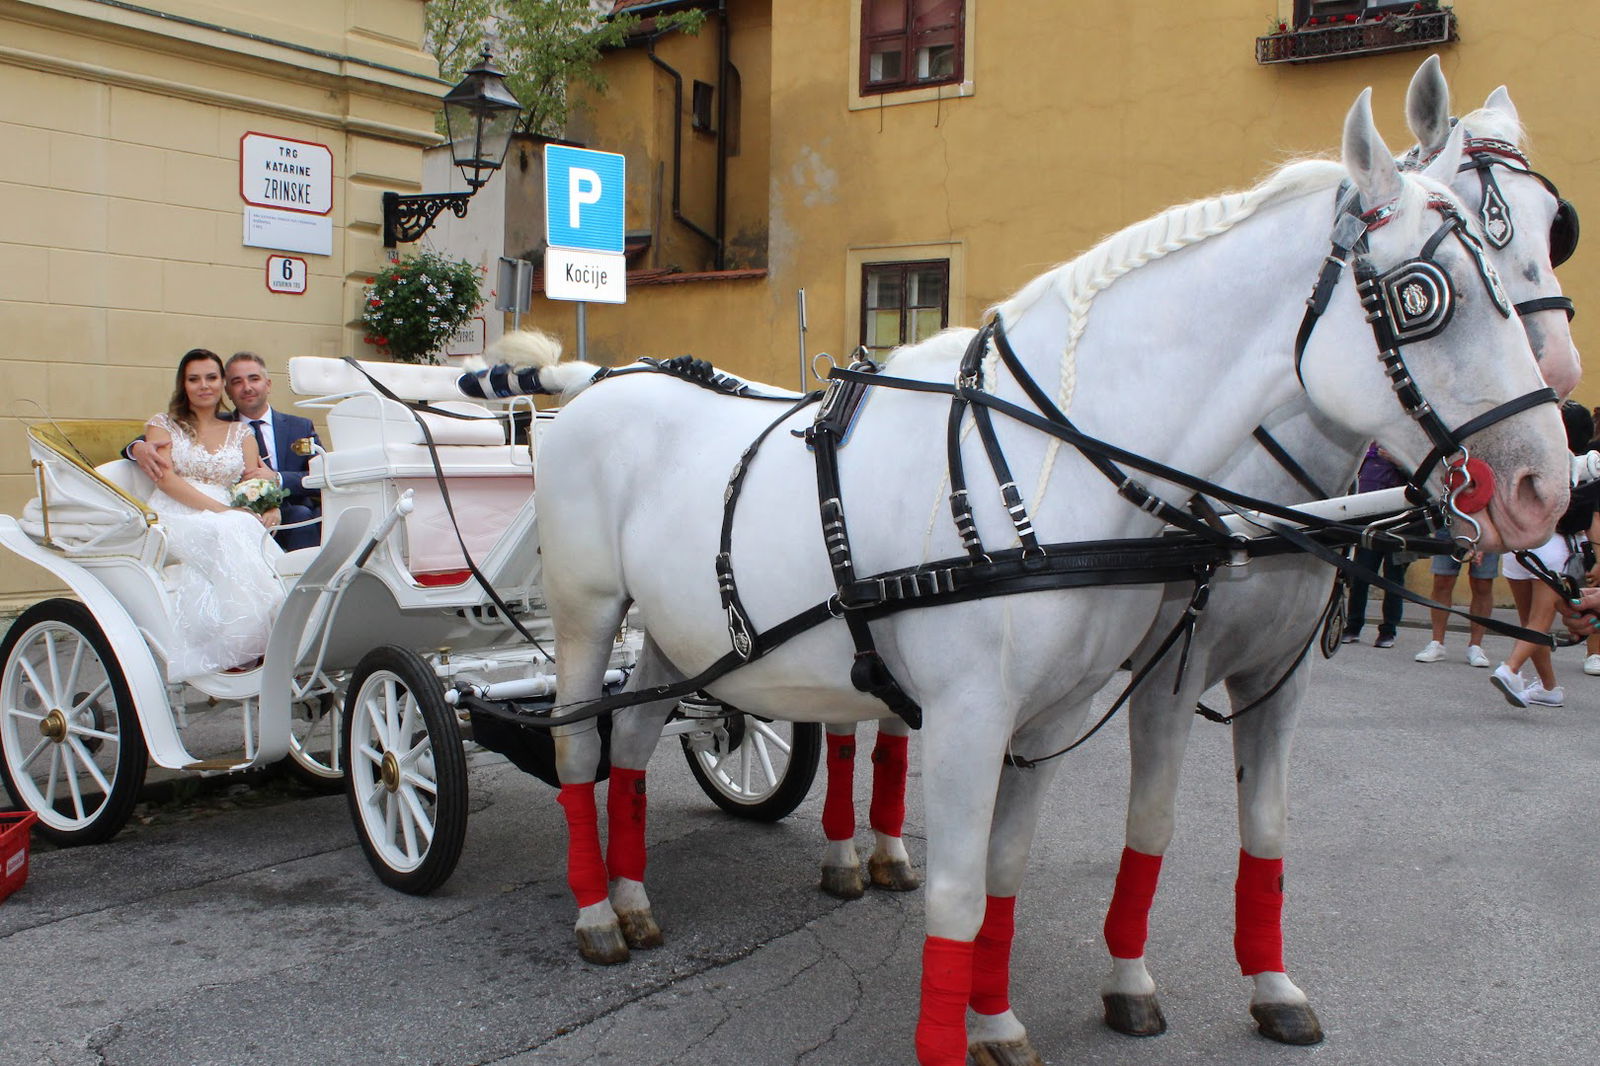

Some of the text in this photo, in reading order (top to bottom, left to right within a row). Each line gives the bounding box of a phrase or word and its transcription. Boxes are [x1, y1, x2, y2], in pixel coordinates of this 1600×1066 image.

[279, 147, 298, 159] TRG
[266, 161, 311, 177] KATARINE
[264, 178, 311, 205] ZRINSKE
[568, 166, 602, 229] P
[282, 258, 293, 281] 6
[566, 263, 607, 289] Kočije
